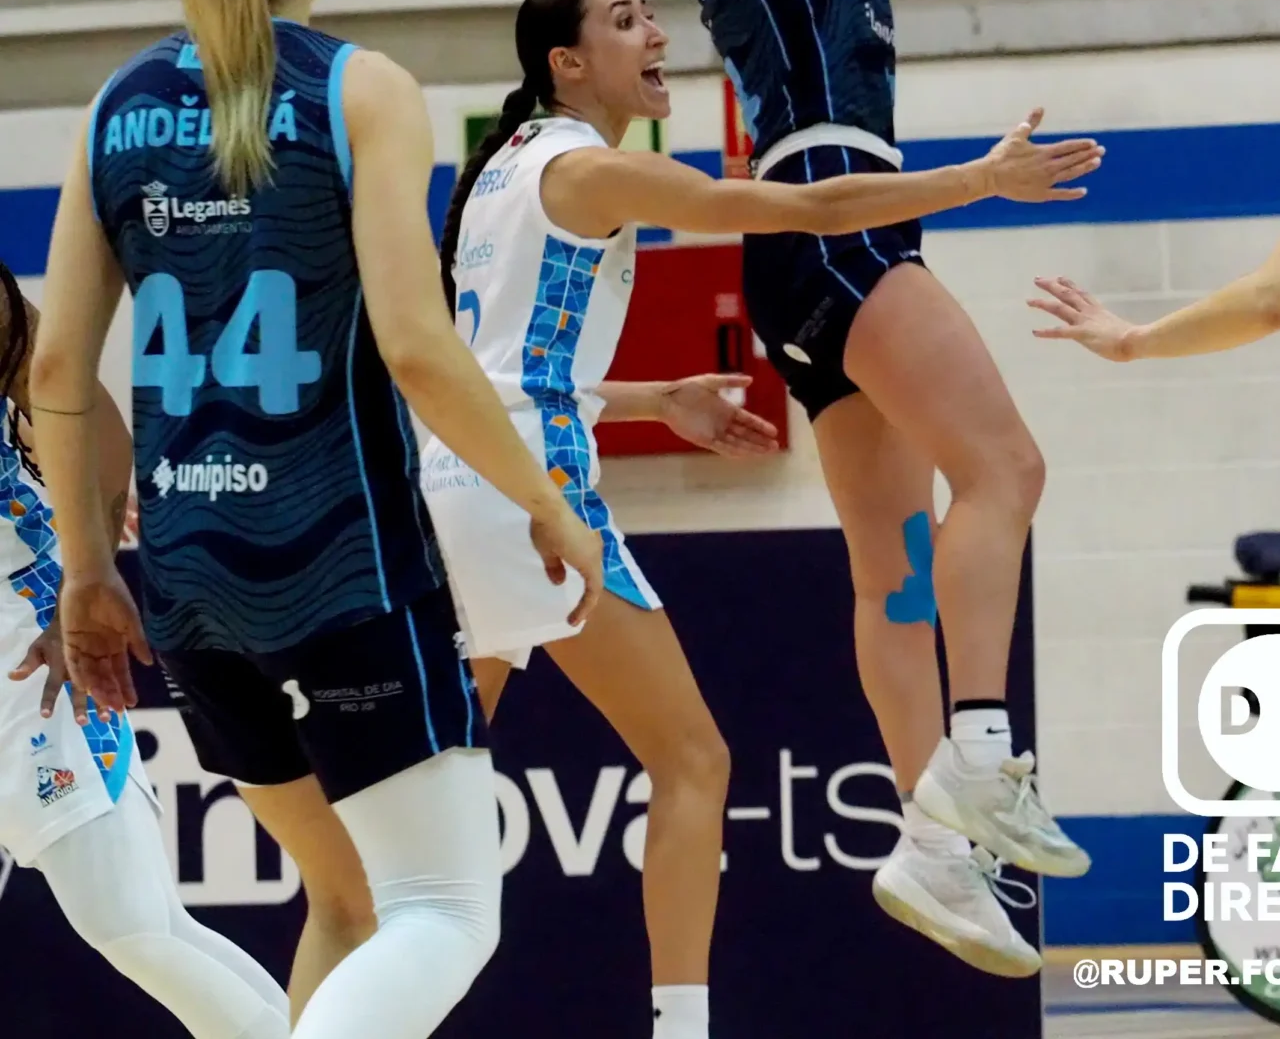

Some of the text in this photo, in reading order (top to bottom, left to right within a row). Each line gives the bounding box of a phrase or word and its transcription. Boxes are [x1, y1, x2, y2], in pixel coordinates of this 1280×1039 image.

[104, 89, 298, 155] ANDĚLÁ
[171, 193, 252, 223] Leganés
[132, 269, 322, 417] 44
[176, 454, 268, 502] unipiso
